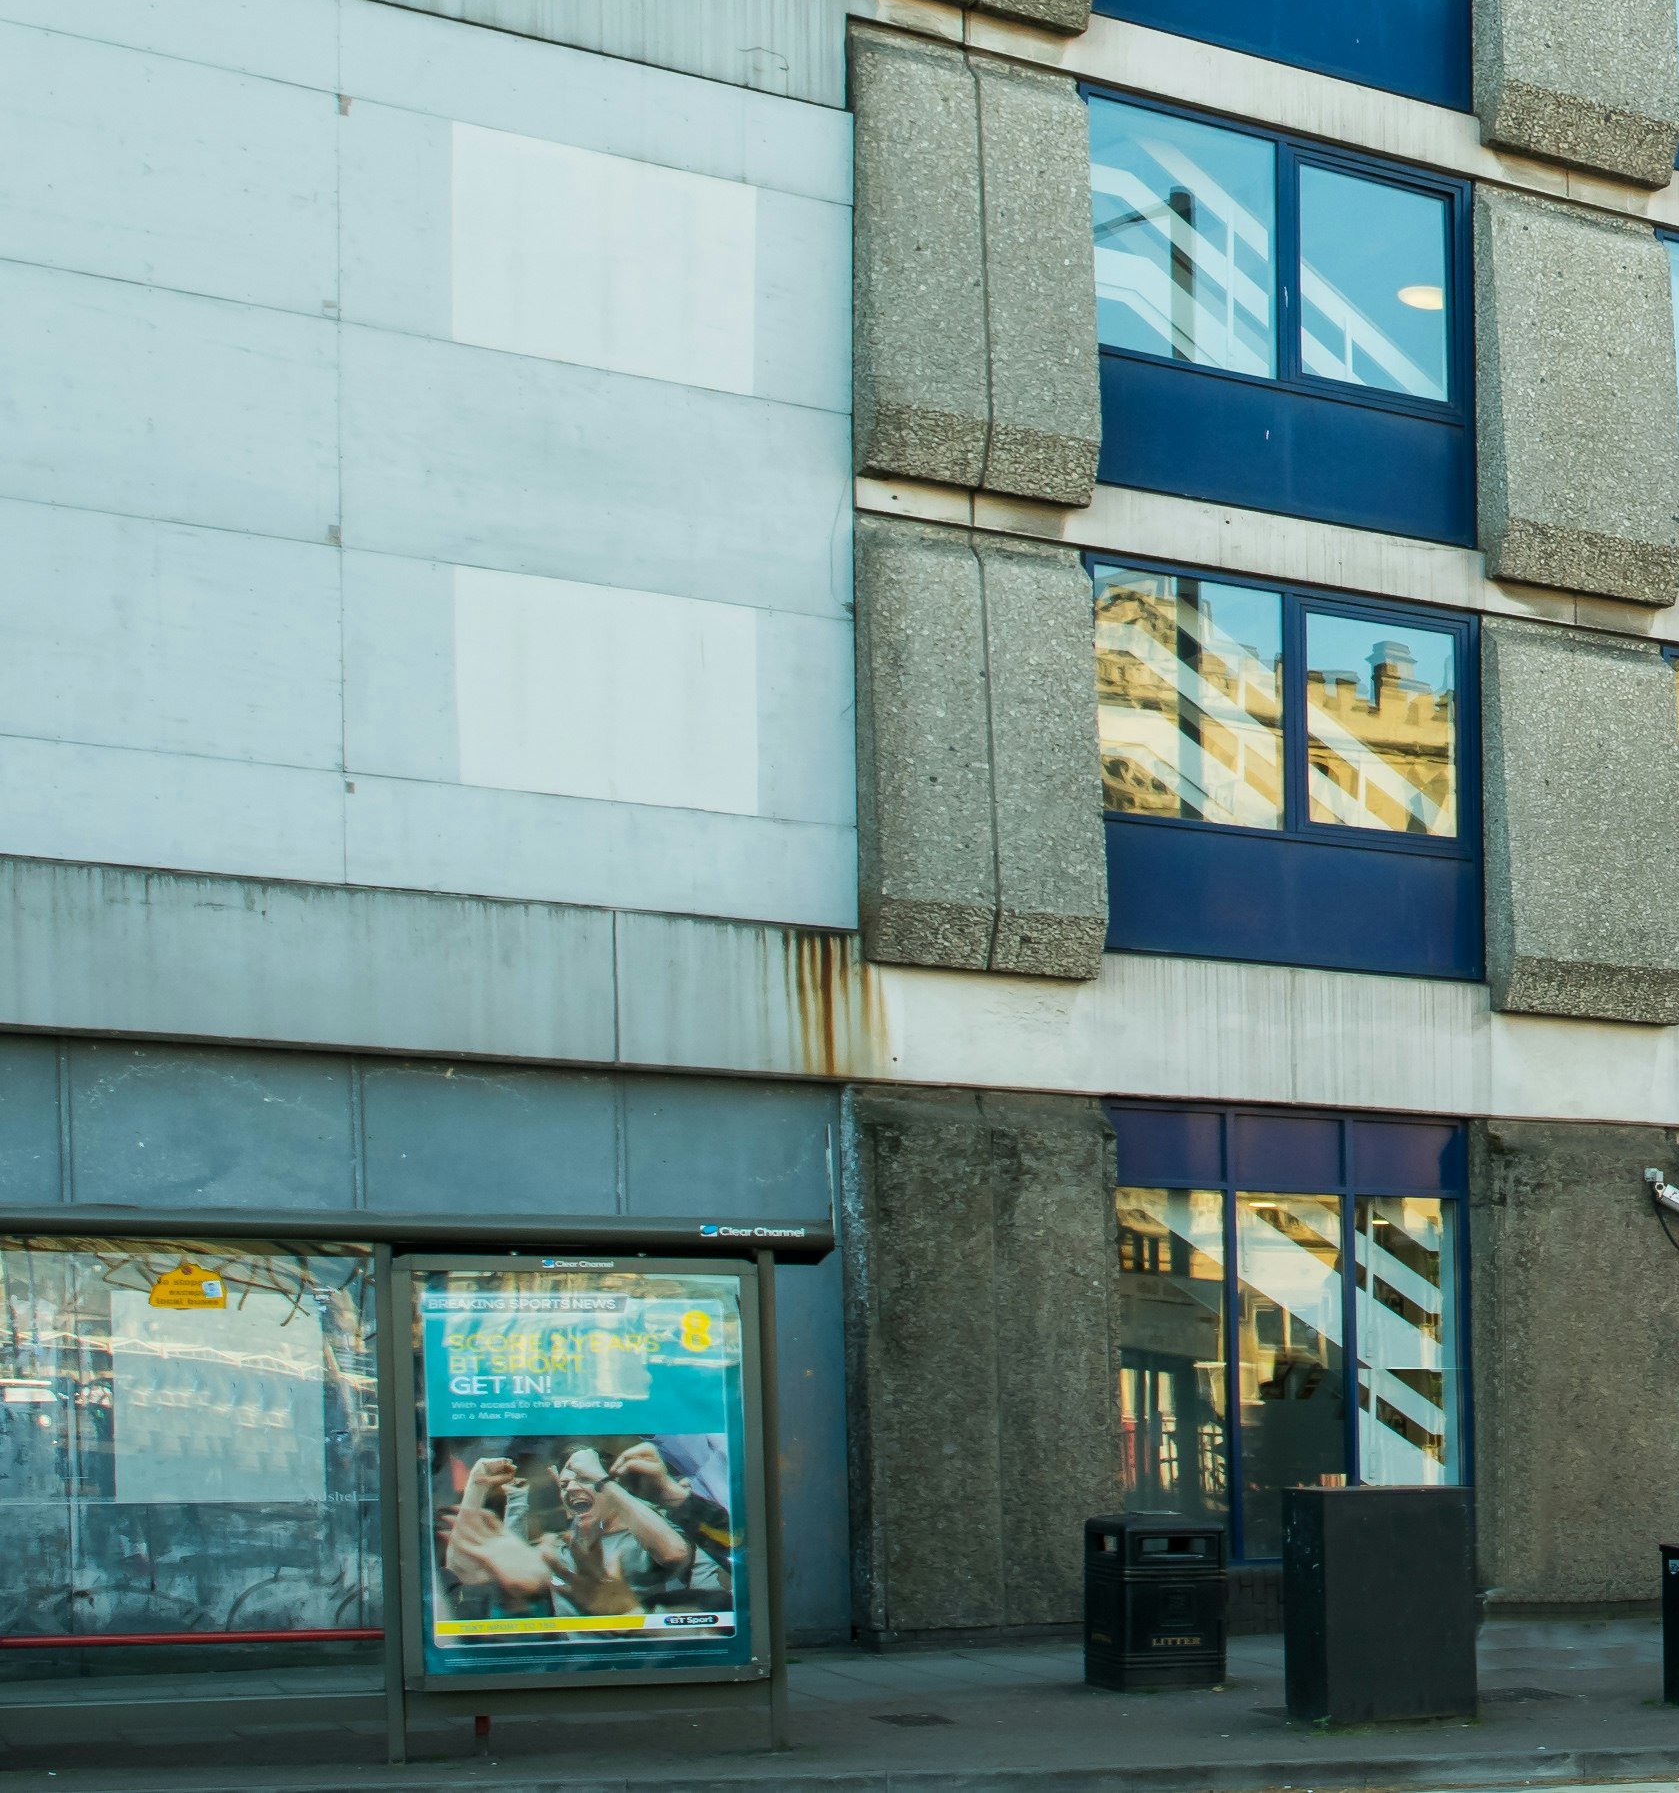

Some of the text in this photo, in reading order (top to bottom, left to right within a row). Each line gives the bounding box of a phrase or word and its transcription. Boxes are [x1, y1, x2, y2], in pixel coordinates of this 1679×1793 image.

[718, 1226, 805, 1238] Clear Channel
[555, 1260, 615, 1269] Clear Channel
[428, 1298, 617, 1310] BREAKING SPORTS NEWS
[448, 1333, 544, 1353] SCORE
[449, 1355, 490, 1375] BT
[450, 1376, 551, 1396] GET IN!
[451, 1401, 477, 1409] With
[553, 1400, 568, 1408] BT
[570, 1400, 602, 1409] Sport
[603, 1400, 624, 1410] app
[686, 1616, 714, 1625] Sport
[1152, 1636, 1202, 1646] LITTER
